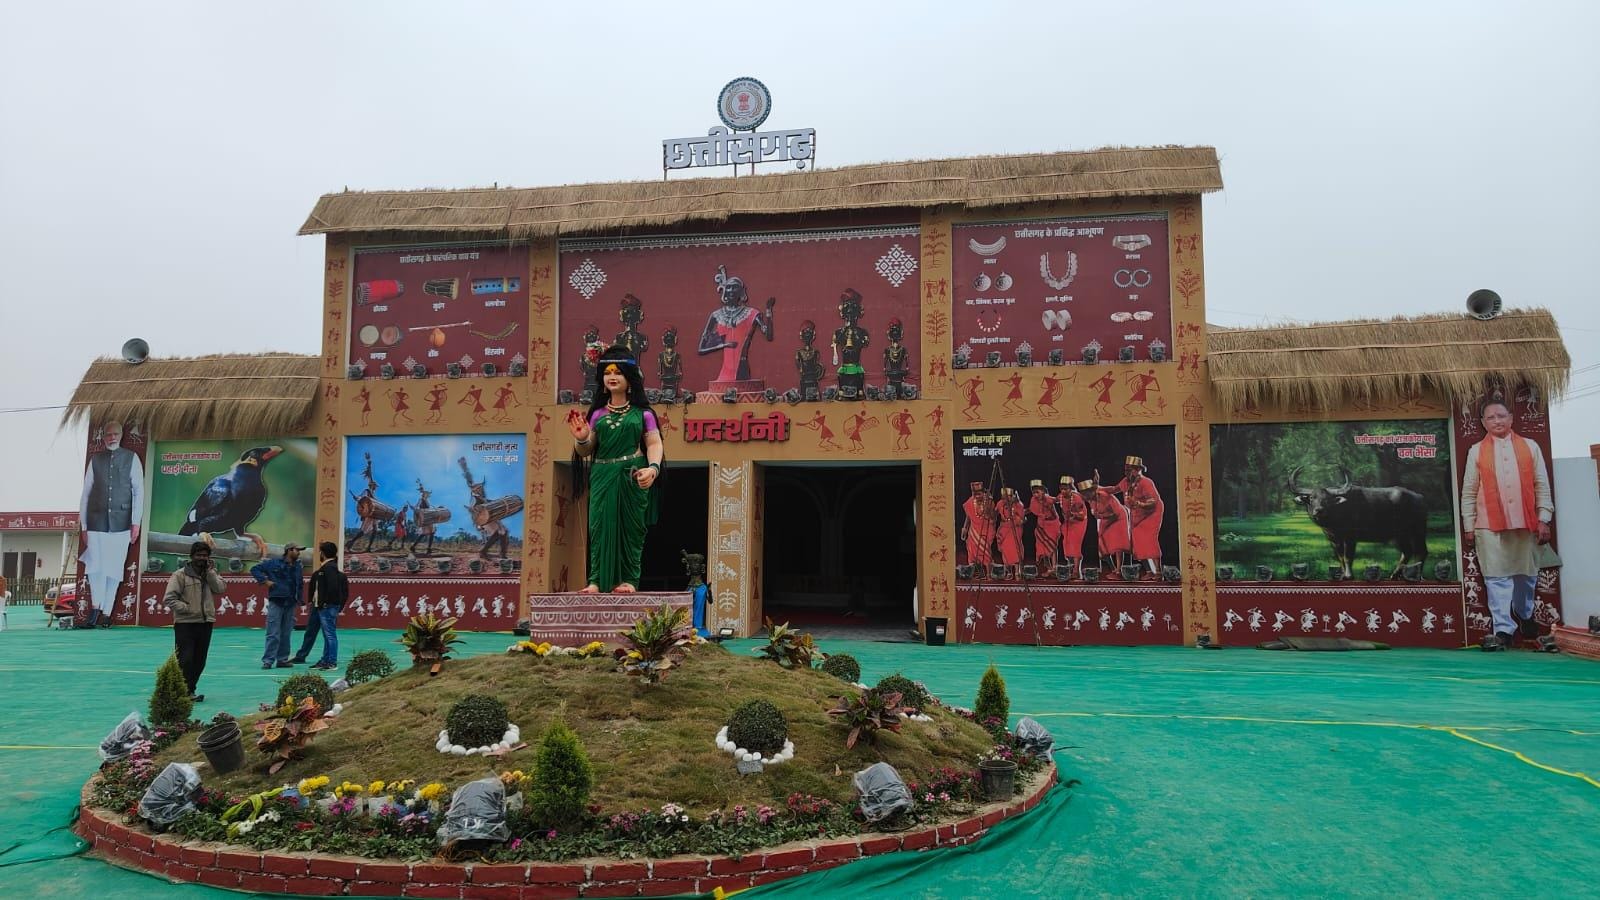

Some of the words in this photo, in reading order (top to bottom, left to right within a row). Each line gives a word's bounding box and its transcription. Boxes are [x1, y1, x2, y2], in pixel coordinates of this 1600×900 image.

[662, 125, 815, 169] छत्तीसगढ़
[684, 411, 790, 443] प्रदर्शनी
[996, 435, 1011, 447] नृत्य
[988, 448, 1003, 459] नृत्य
[1397, 447, 1414, 458] वन
